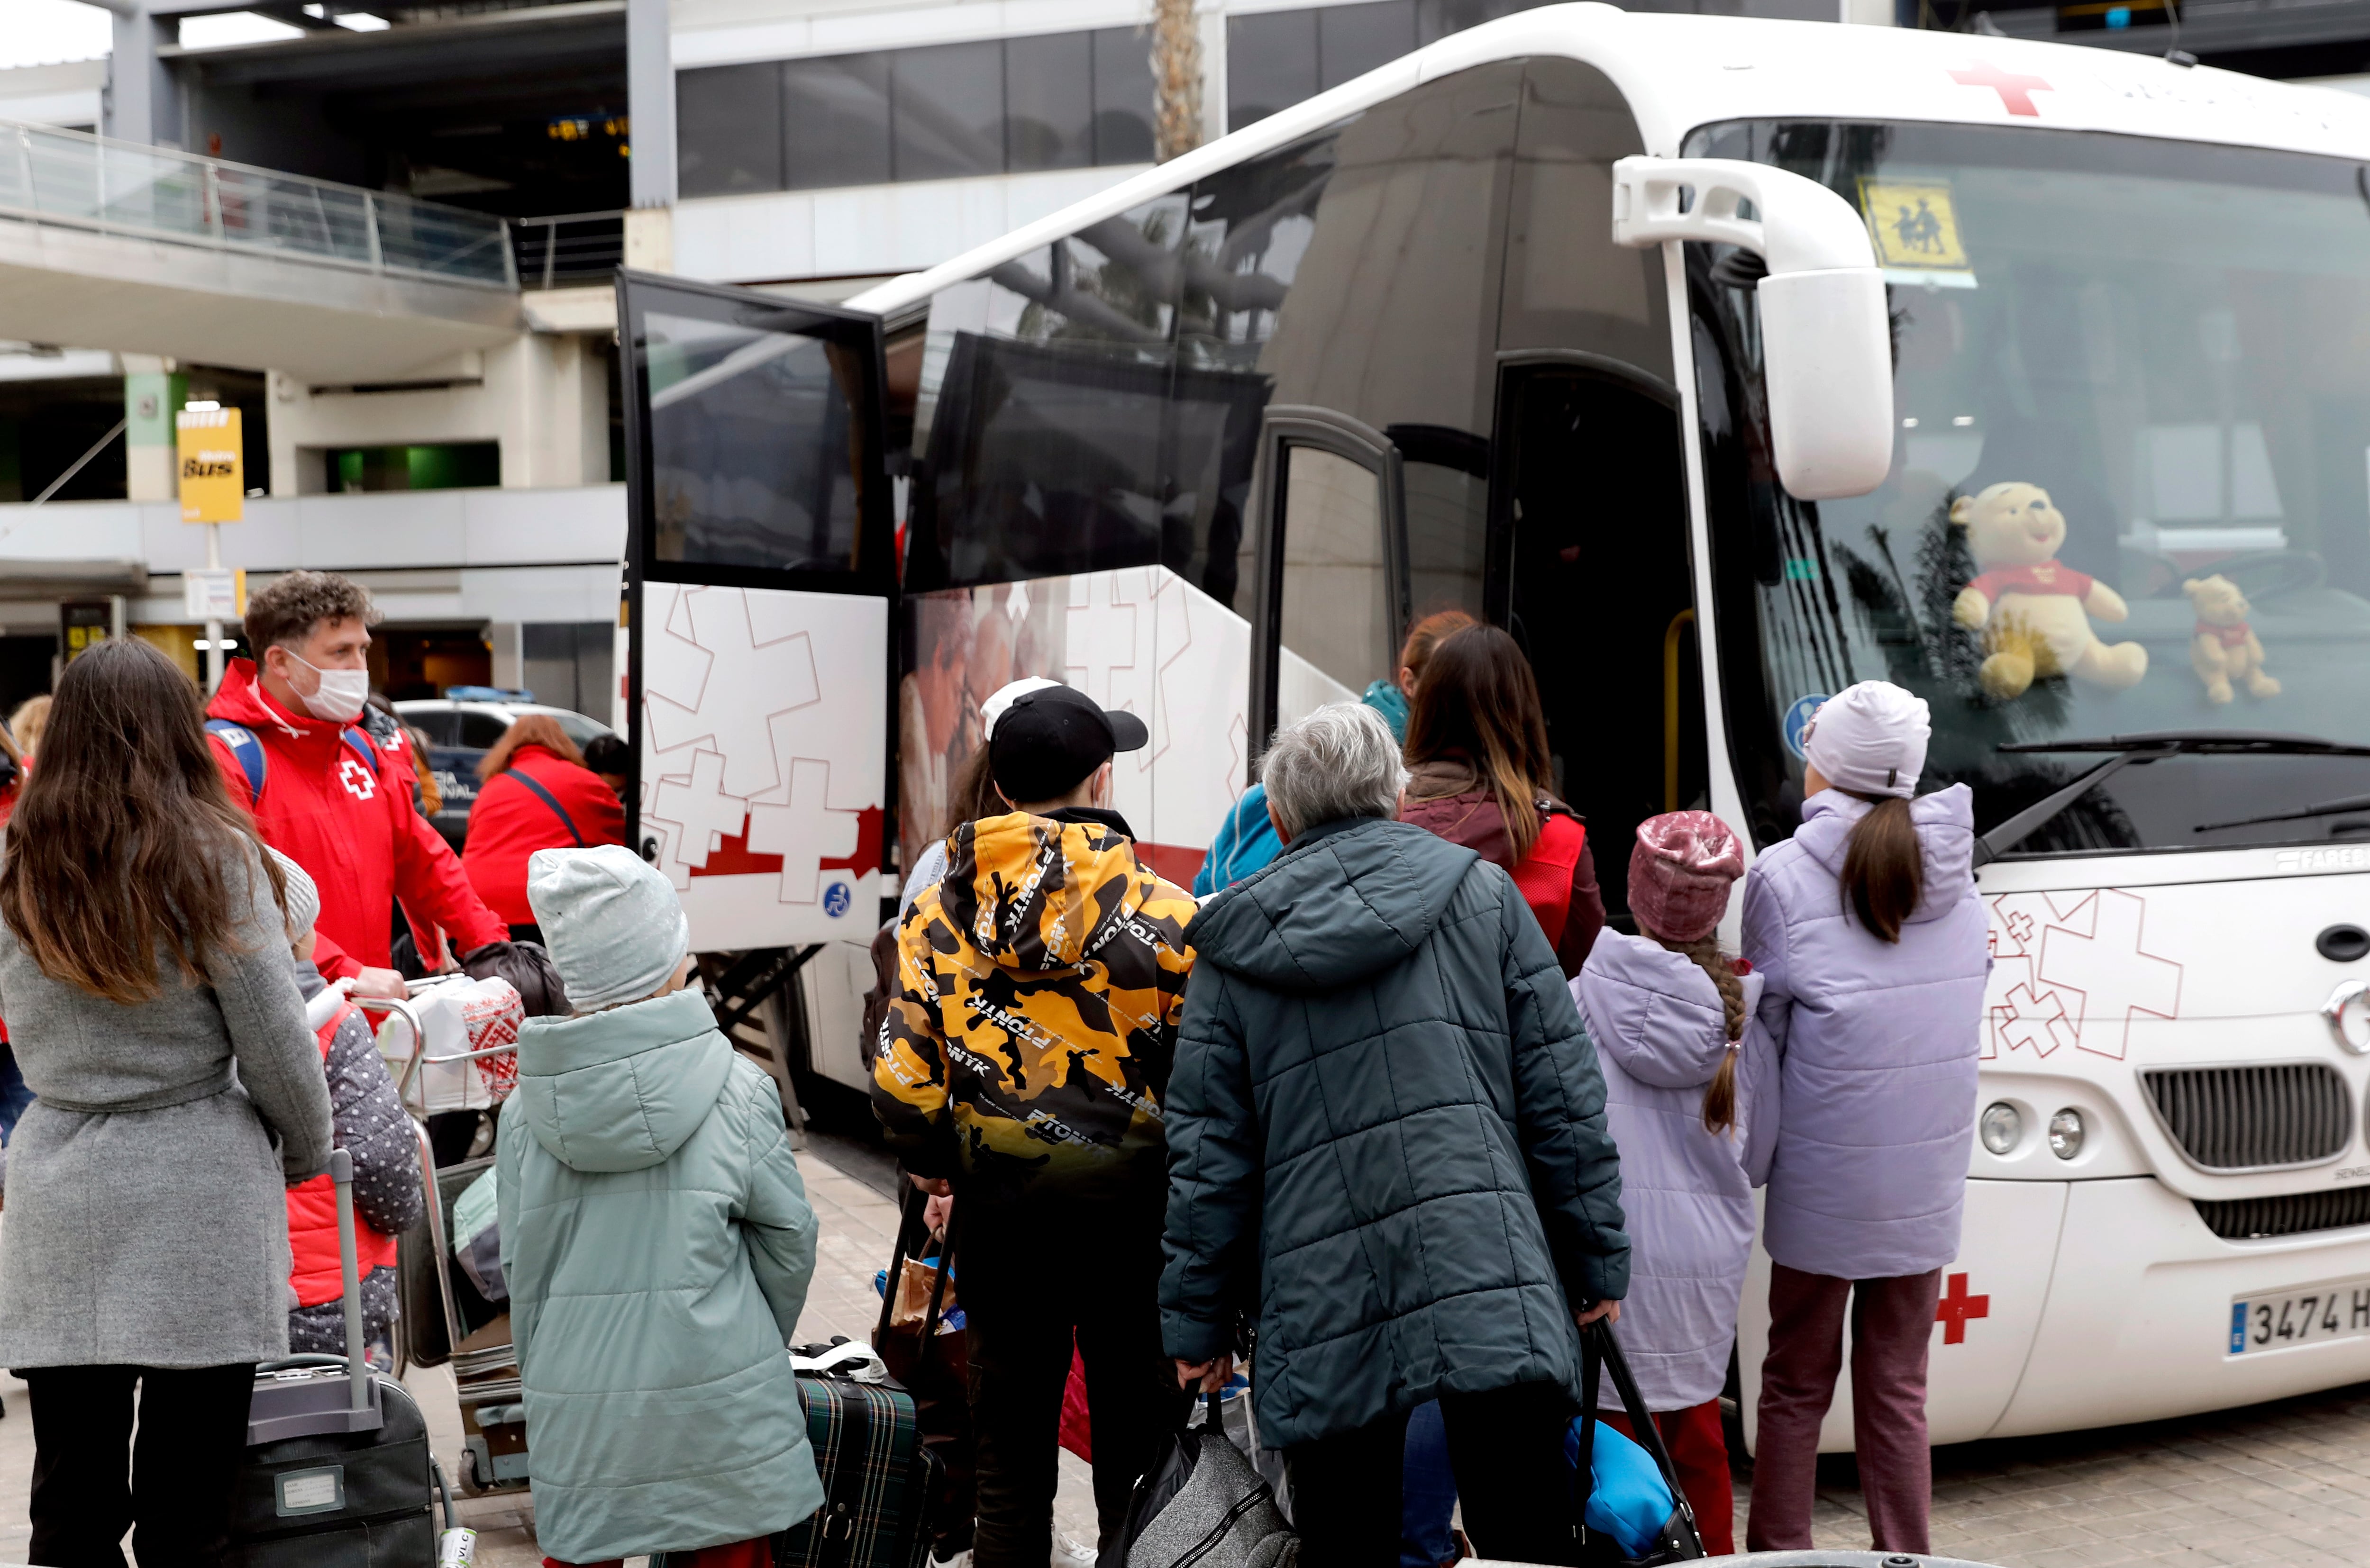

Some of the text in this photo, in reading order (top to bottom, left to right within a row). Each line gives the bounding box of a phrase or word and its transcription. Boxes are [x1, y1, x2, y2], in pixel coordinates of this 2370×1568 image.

[184, 458, 233, 479] Bus
[1039, 831, 1047, 846] THEY
[1005, 846, 1055, 933] PTONYK
[1110, 899, 1123, 915] COME
[1105, 913, 1113, 923] UP
[1136, 915, 1150, 926] WITH
[1097, 921, 1108, 934] WITH
[1149, 923, 1158, 931] UP
[963, 964, 975, 974] SEE
[1014, 1009, 1028, 1020] WITH
[967, 994, 1051, 1050] PTONYK
[1035, 1022, 1052, 1034] COME
[1052, 1032, 1067, 1043] THEY
[902, 1059, 917, 1074] COME
[984, 1097, 995, 1106] SEE
[995, 1105, 1011, 1116] WHAT
[2253, 1293, 2339, 1344] 3474
